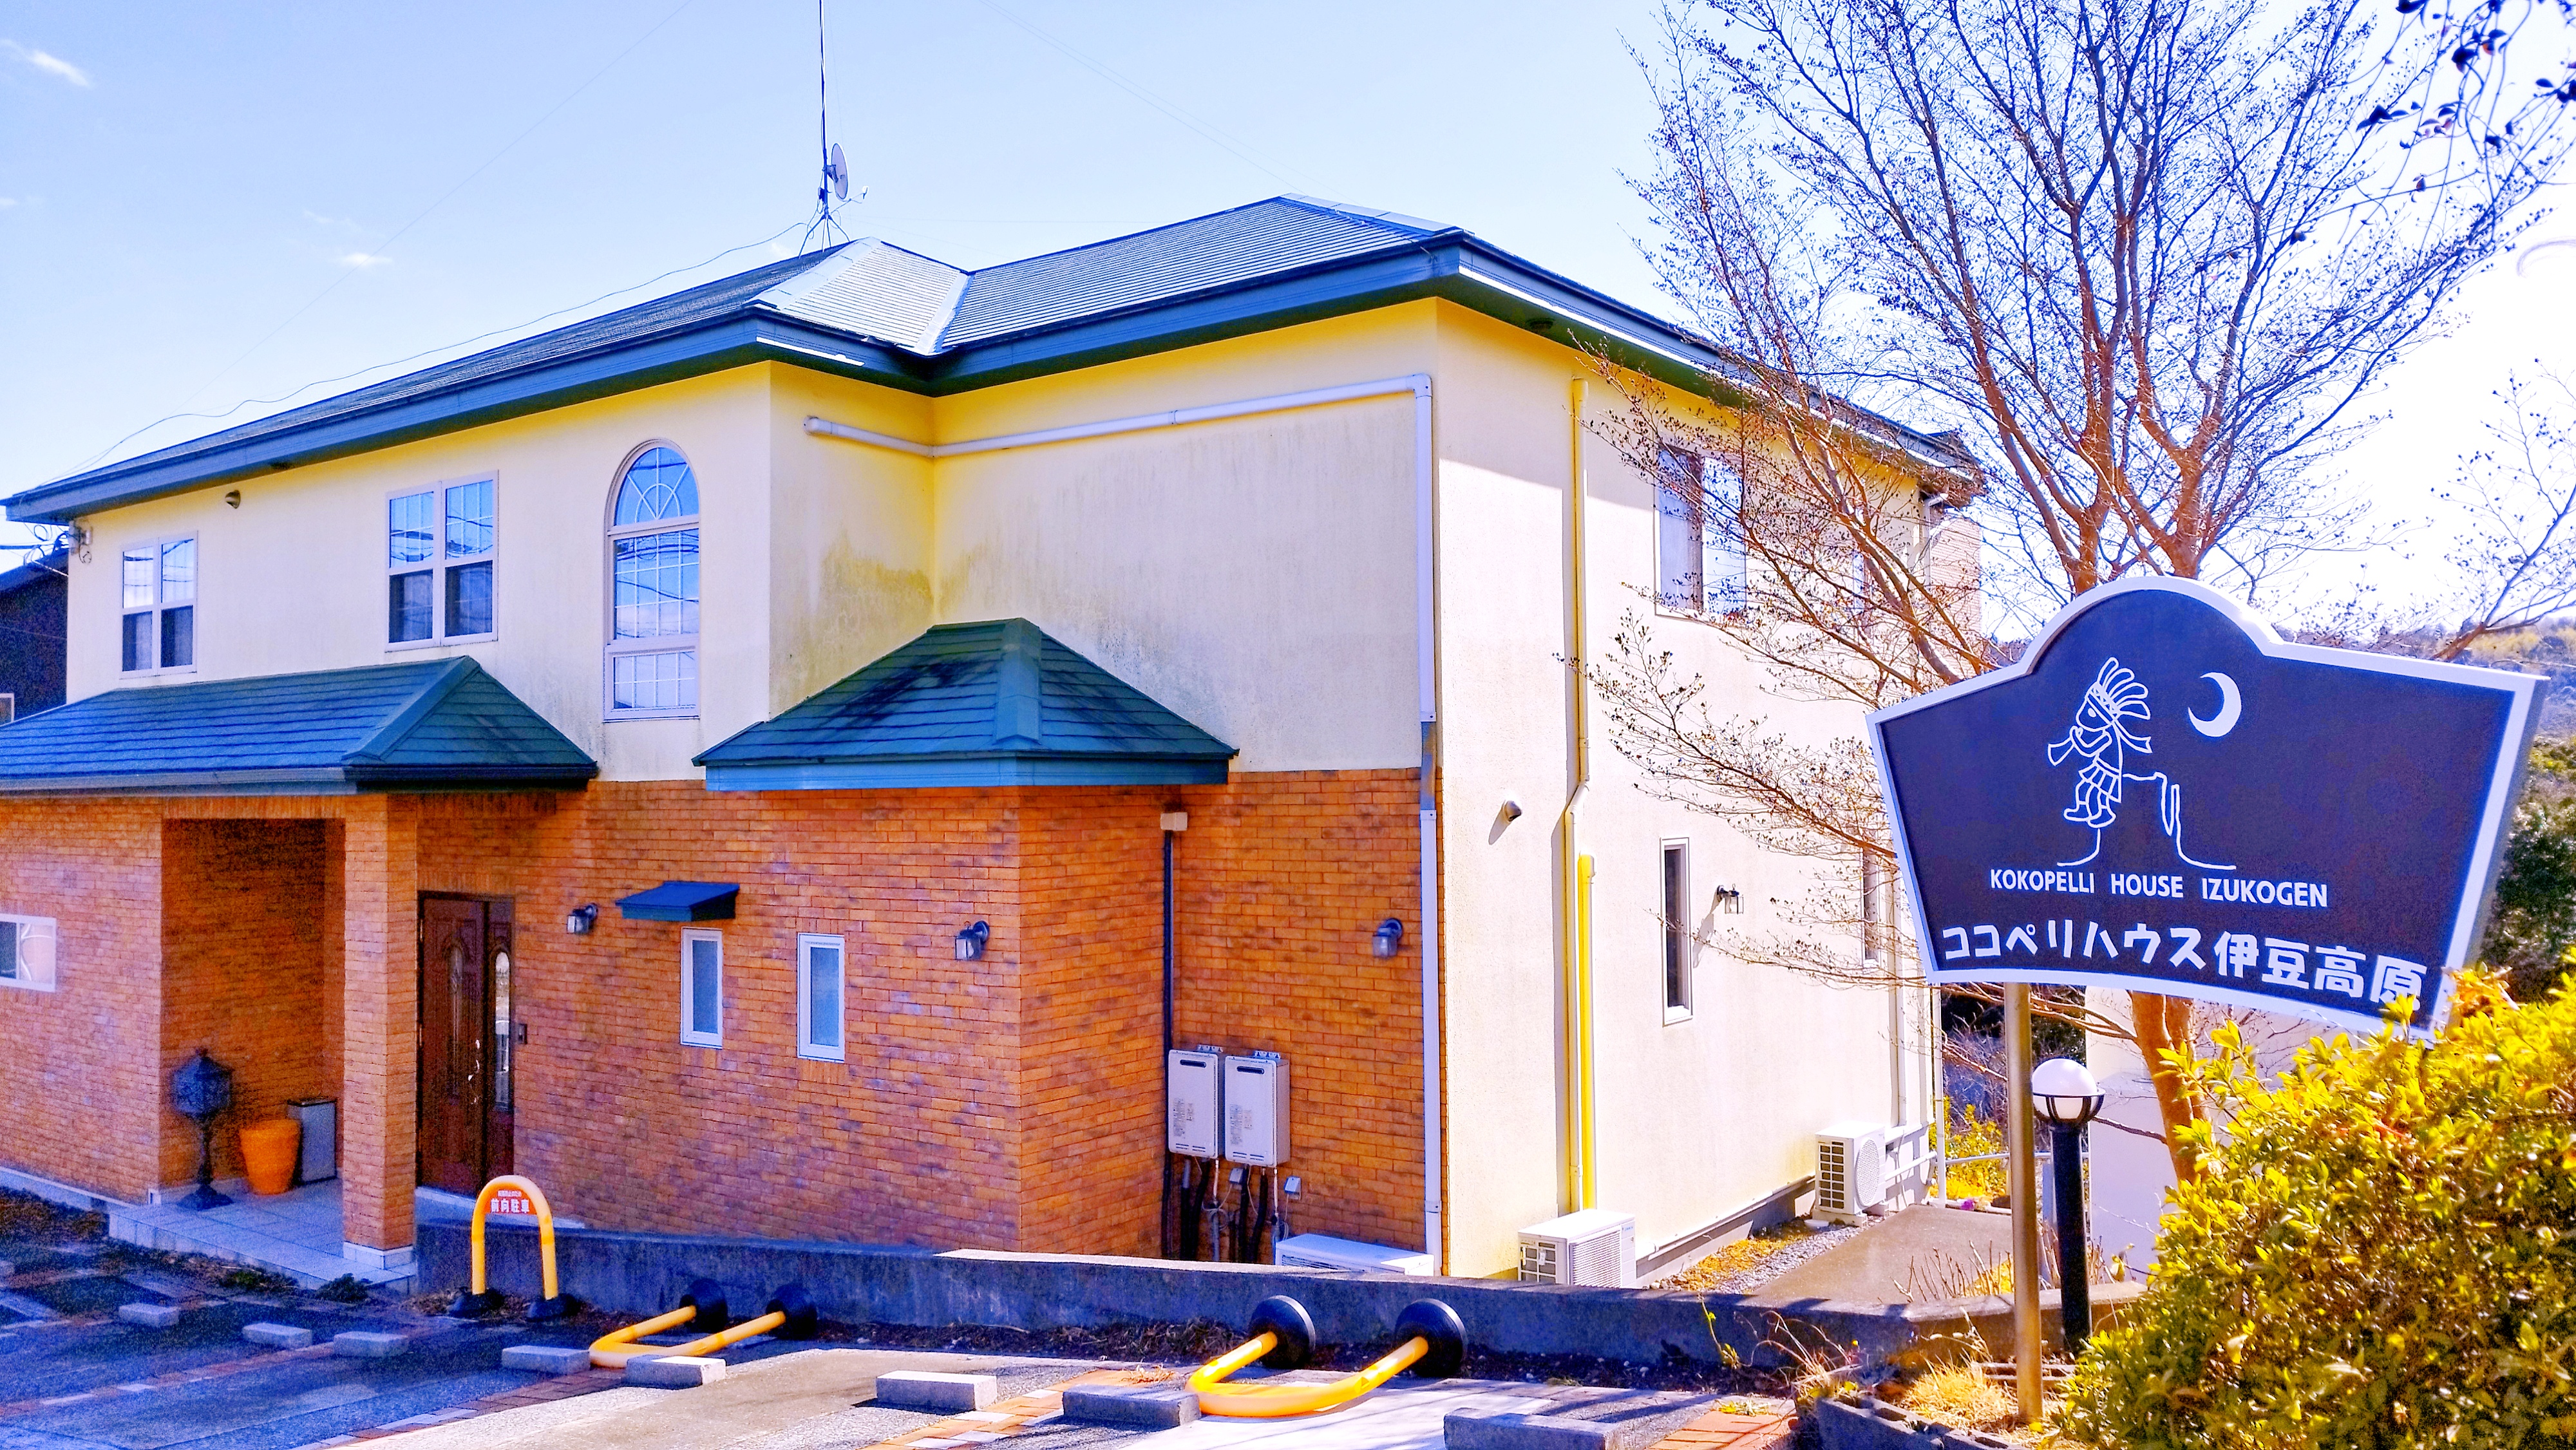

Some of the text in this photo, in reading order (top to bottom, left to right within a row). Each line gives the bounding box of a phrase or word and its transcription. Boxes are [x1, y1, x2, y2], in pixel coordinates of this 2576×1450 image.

[1991, 869, 2327, 907] KOKOPELLI HOUSE IZUKOGEN
[1942, 919, 2427, 1011] ココペリハウス伊豆高原
[490, 1198, 530, 1214] 前向駐車
